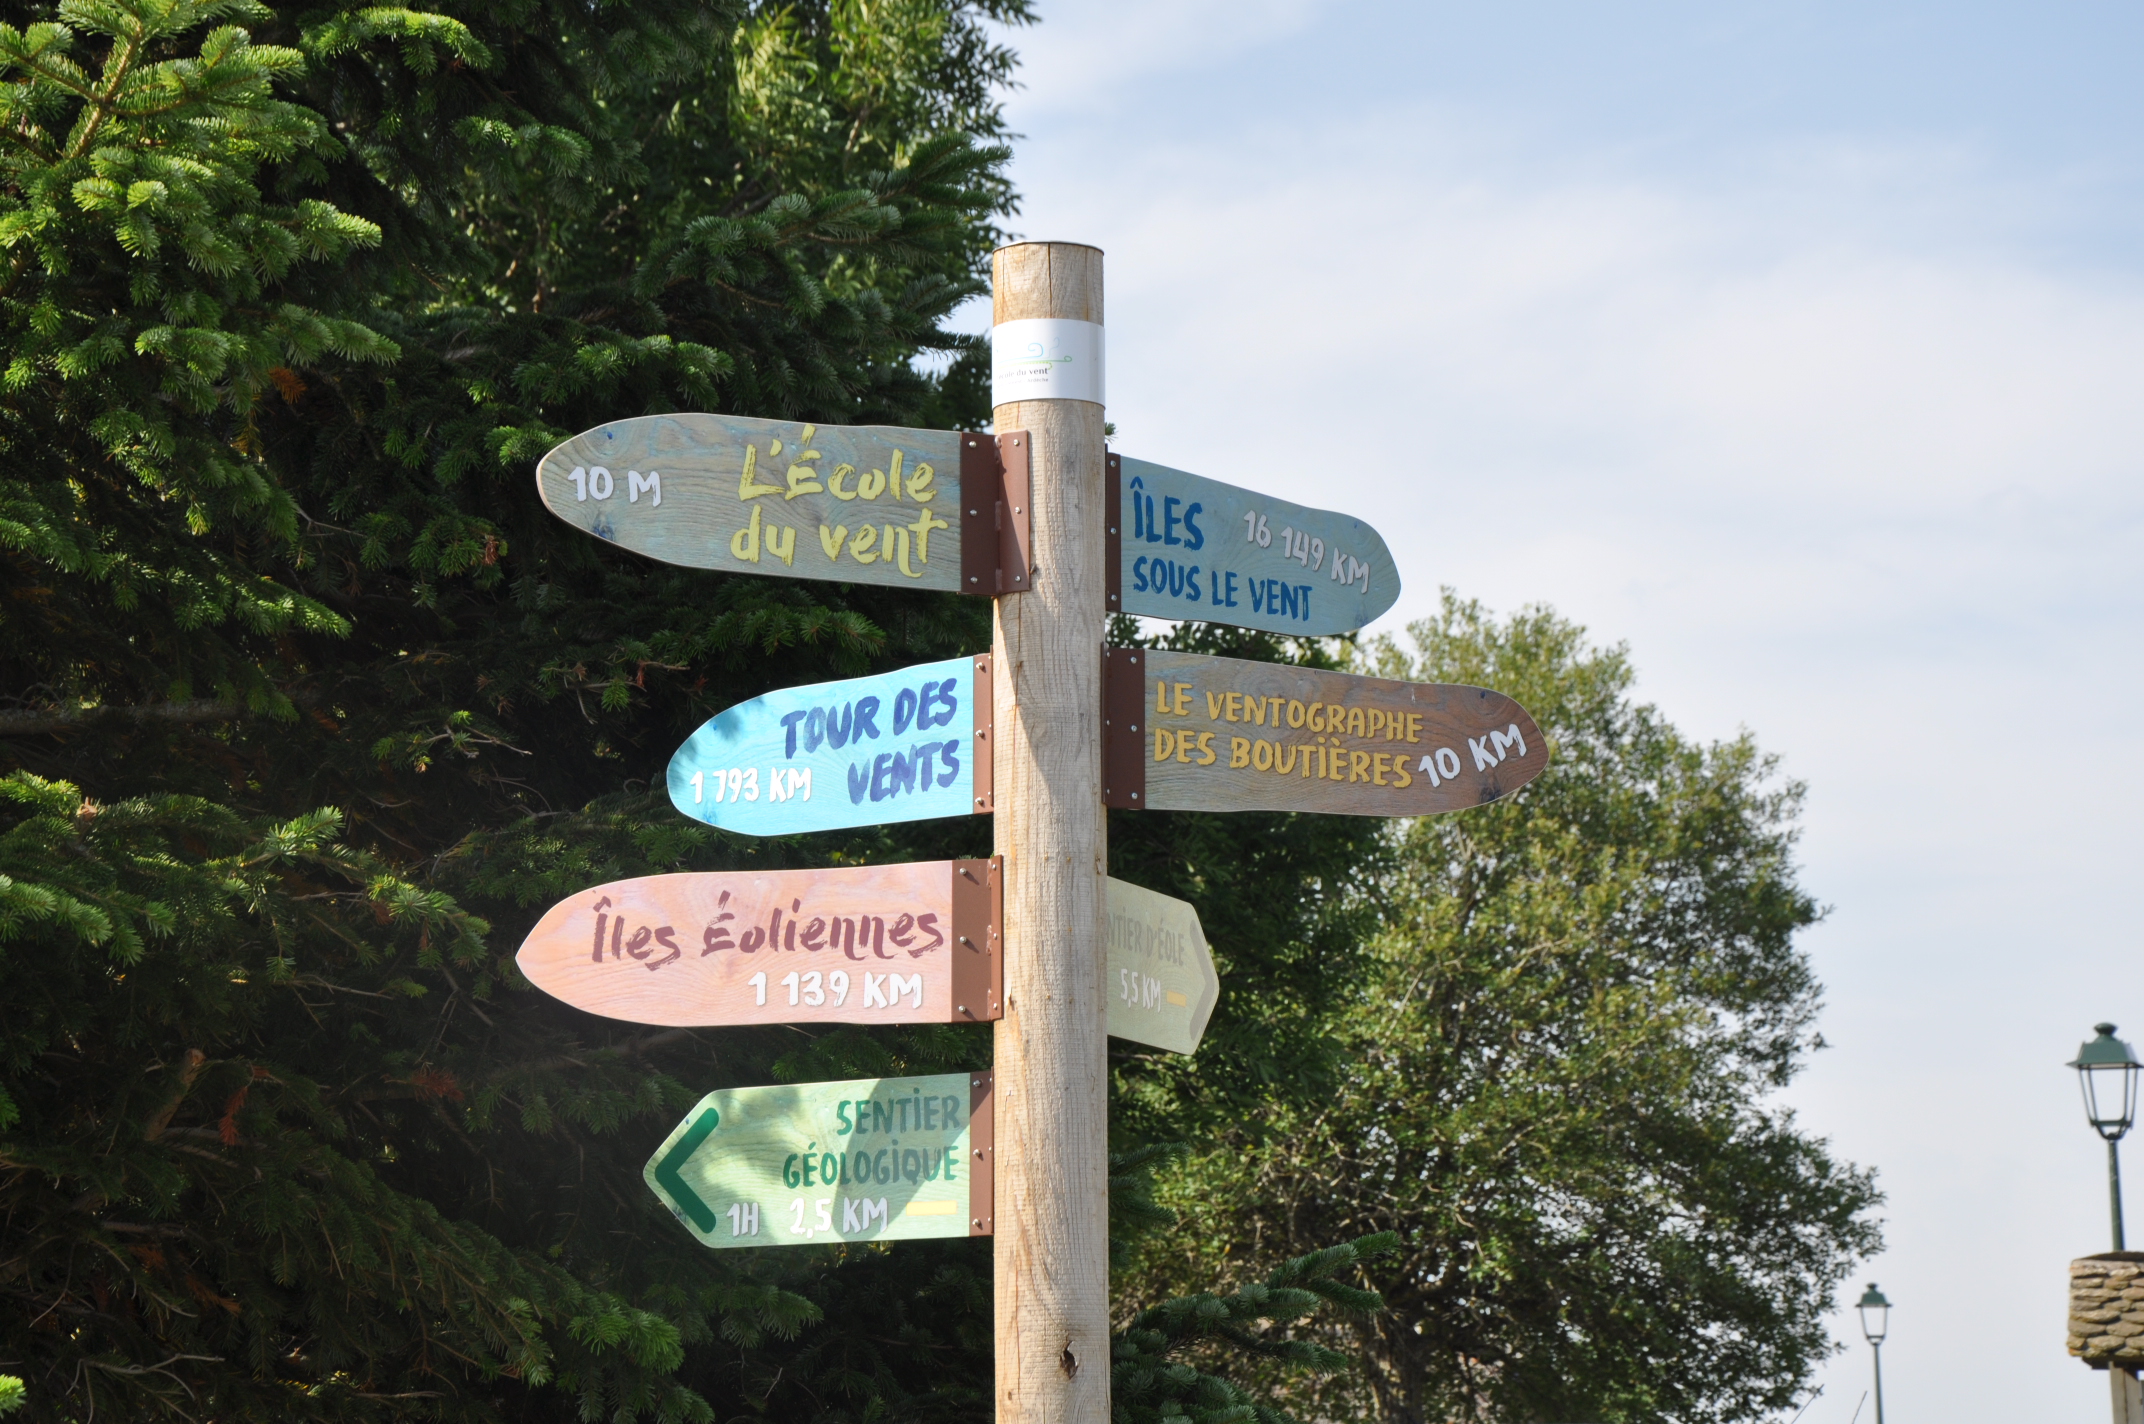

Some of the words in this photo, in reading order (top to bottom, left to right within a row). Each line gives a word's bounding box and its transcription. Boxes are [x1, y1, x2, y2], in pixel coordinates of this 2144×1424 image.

[1029, 367, 1048, 375] vent
[568, 466, 614, 502] 10
[628, 470, 661, 507] M
[738, 423, 937, 502] L'École
[730, 504, 796, 567] du
[819, 507, 949, 579] vent
[1130, 476, 1204, 551] ÎLES
[1243, 510, 1272, 548] 16
[1281, 526, 1325, 572] 149
[1331, 547, 1370, 594] KM
[1133, 556, 1201, 602] SOUS
[1211, 570, 1238, 608] LE
[1249, 578, 1313, 622] VENT
[780, 695, 880, 760] TOUR
[893, 678, 958, 737] DES
[1156, 681, 1193, 715] LE
[1206, 691, 1424, 744] VENTOGRAPHE
[690, 771, 704, 804] 1
[712, 767, 760, 803] 793
[769, 766, 812, 803] KM
[847, 739, 960, 806] VENTS
[1154, 728, 1216, 766] DES
[1229, 735, 1412, 788] BOUTIÈRES
[1418, 747, 1461, 788] 10
[1468, 723, 1527, 772] KM
[592, 895, 681, 971] Îles
[701, 890, 944, 961] Éoliennes
[1107, 907, 1142, 953] NTIER
[748, 971, 767, 1007] 1
[781, 970, 851, 1008] 139
[863, 971, 923, 1010] KM
[1121, 968, 1138, 1008] 5,5
[1143, 973, 1161, 1012] KM
[836, 1087, 961, 1136] SENTIER
[782, 1139, 960, 1189] GÉOLOGIQUE
[726, 1202, 759, 1237] 1H
[790, 1197, 832, 1239] 2,5
[843, 1197, 888, 1235] KM
